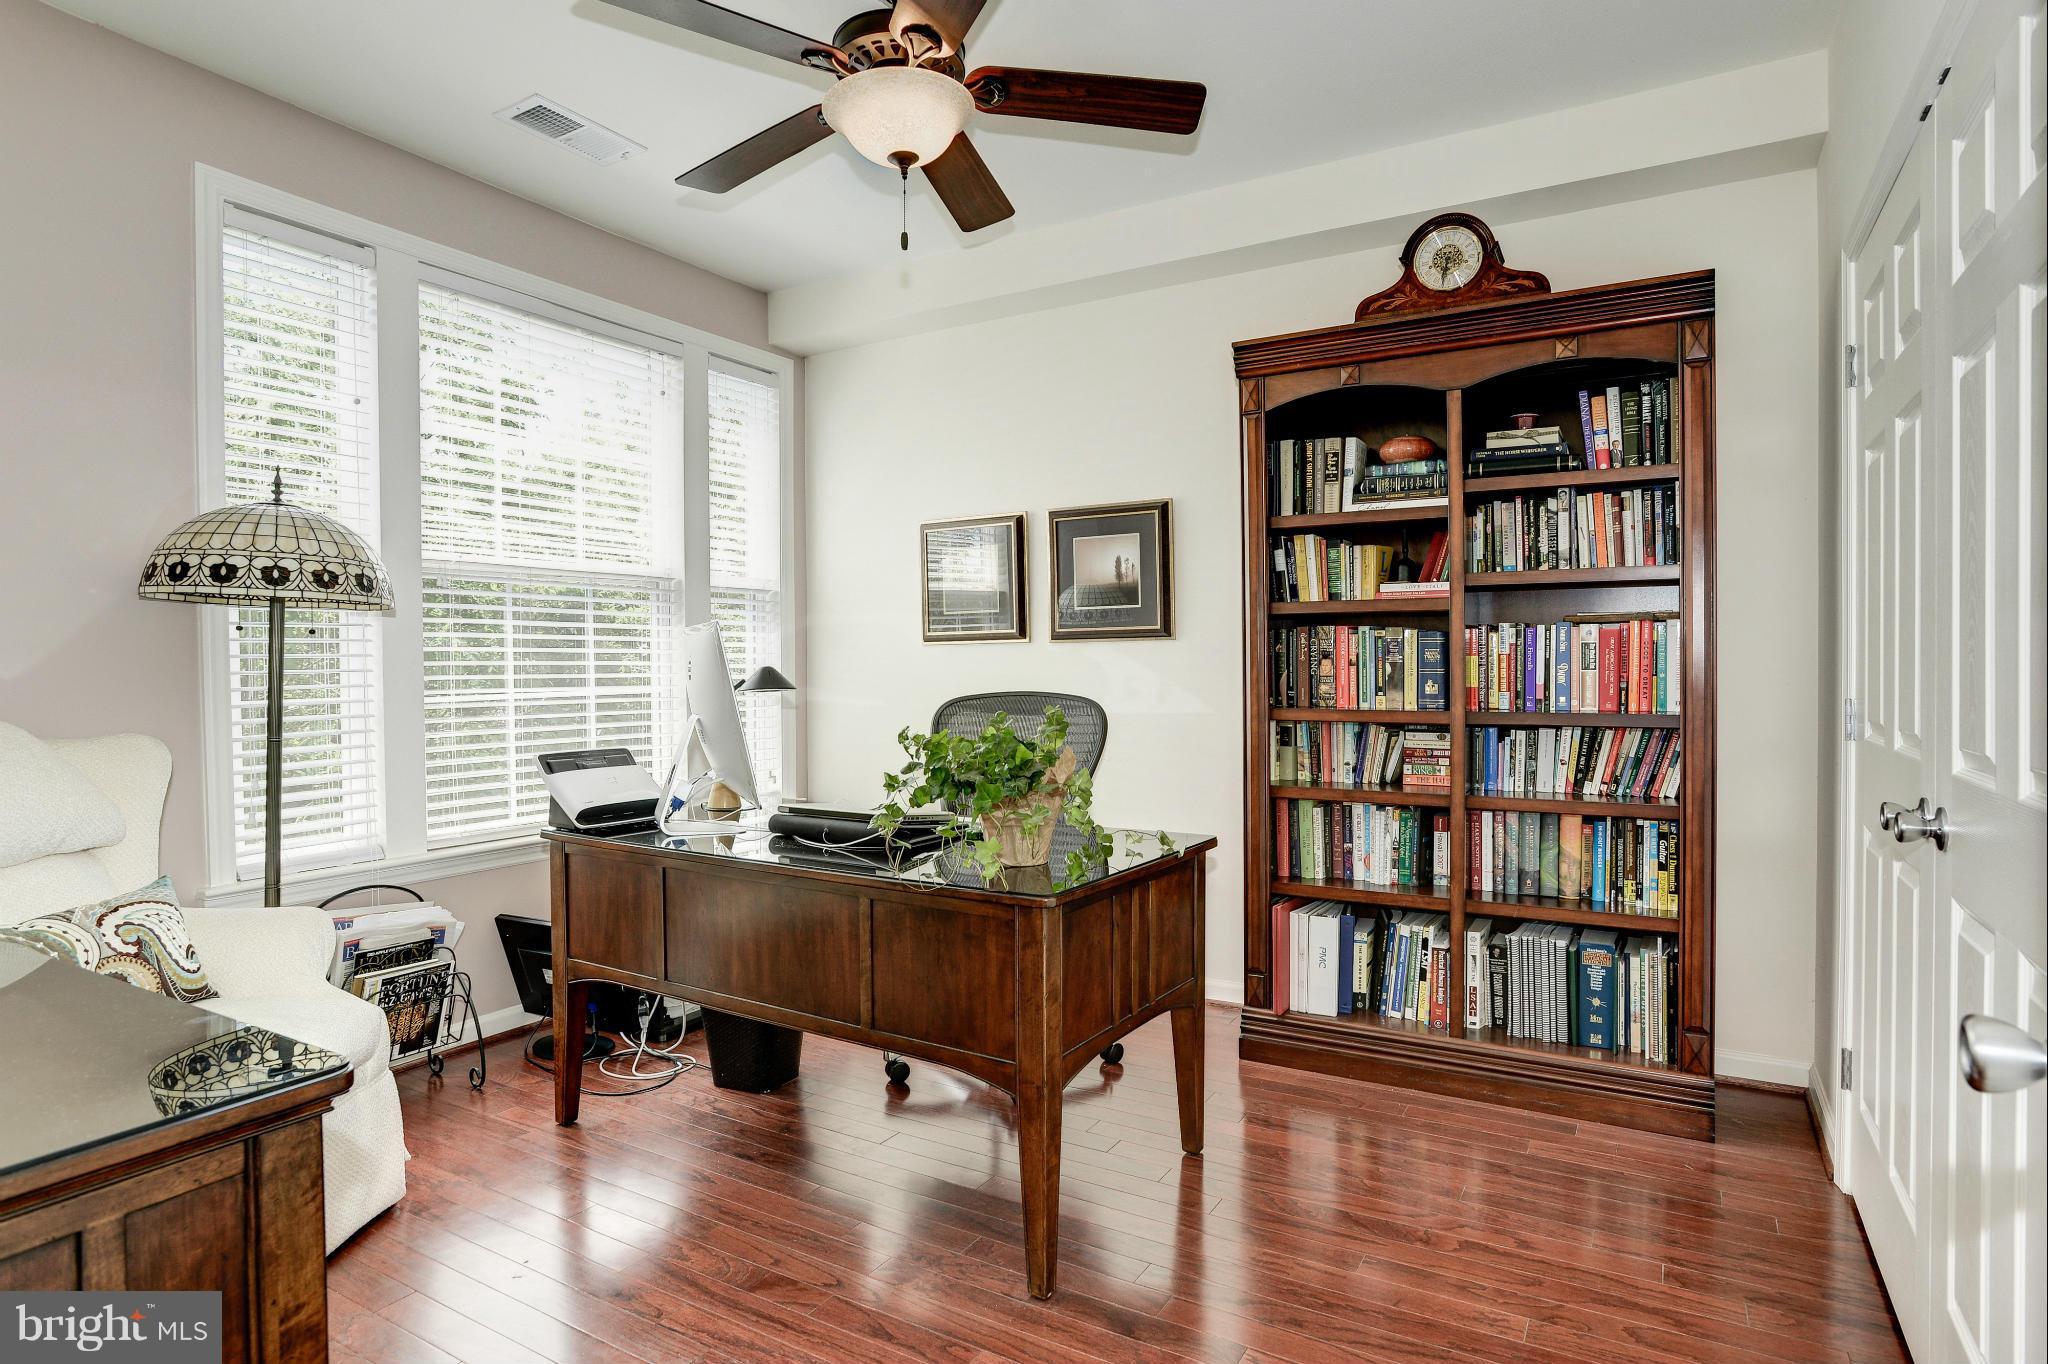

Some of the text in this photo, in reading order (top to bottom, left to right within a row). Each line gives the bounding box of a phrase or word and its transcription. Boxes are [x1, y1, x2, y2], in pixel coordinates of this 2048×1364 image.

[1579, 392, 1590, 422] DIANA
[1642, 395, 1652, 424] MORIARTY
[1305, 463, 1313, 488] SHELDON
[1548, 519, 1557, 552] MIDDLESEX
[1310, 638, 1318, 676] CRYING
[1643, 664, 1648, 673] TO
[1637, 733, 1650, 759] STARDUST
[1659, 840, 1667, 864] Guitar
[1669, 834, 1677, 892] Chess Dummies
[1318, 946, 1326, 969] PMC
[1421, 950, 1429, 969] LSAT
[380, 971, 450, 998] FORTUNE
[1436, 987, 1444, 1004] Analysis
[1493, 974, 1504, 1018] SECURITY ANALYSIS
[1469, 986, 1477, 1017] LSAT
